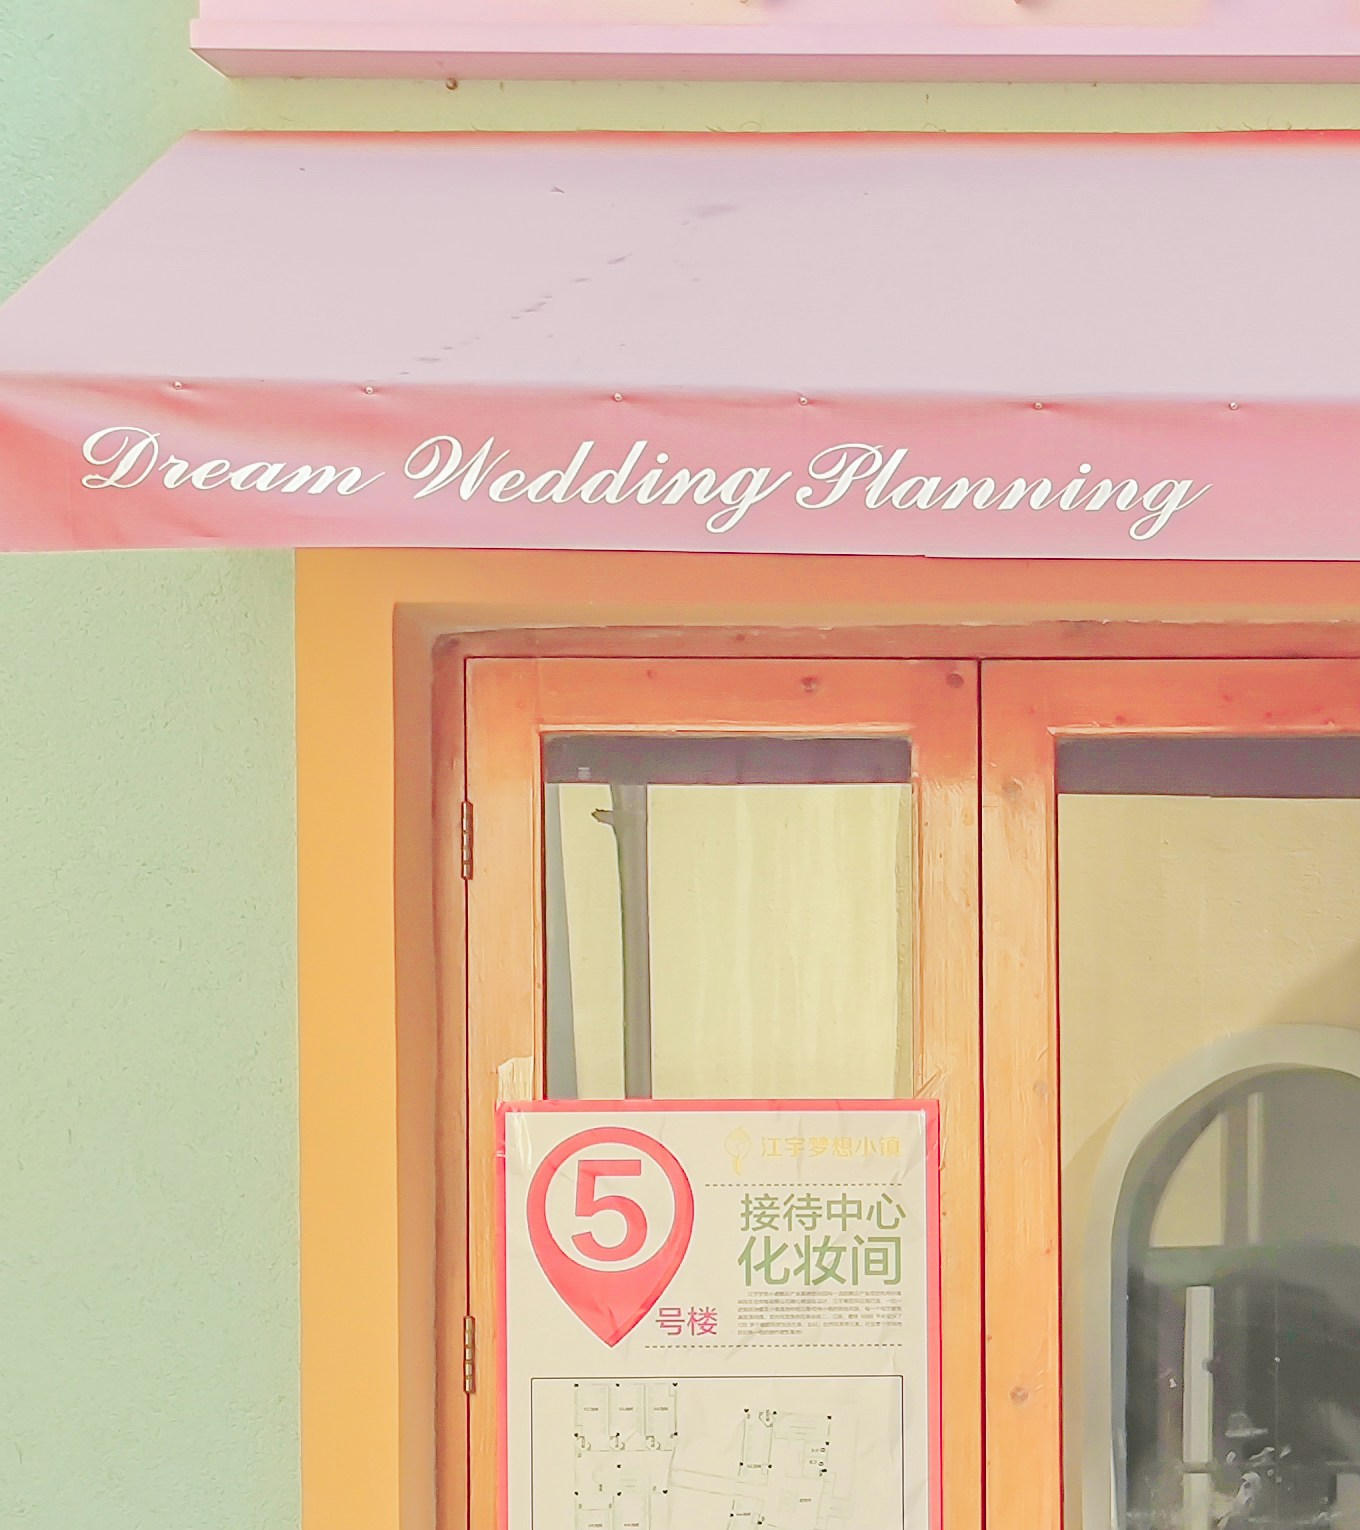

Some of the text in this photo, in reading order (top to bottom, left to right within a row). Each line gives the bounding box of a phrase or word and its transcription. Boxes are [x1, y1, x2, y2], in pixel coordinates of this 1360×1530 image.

[82, 426, 1211, 540] Dream Wedding Planning
[571, 1159, 648, 1262] 5
[740, 1192, 906, 1232] 接待中心
[737, 1234, 902, 1287] 化妆间
[655, 1306, 718, 1337] 号楼
